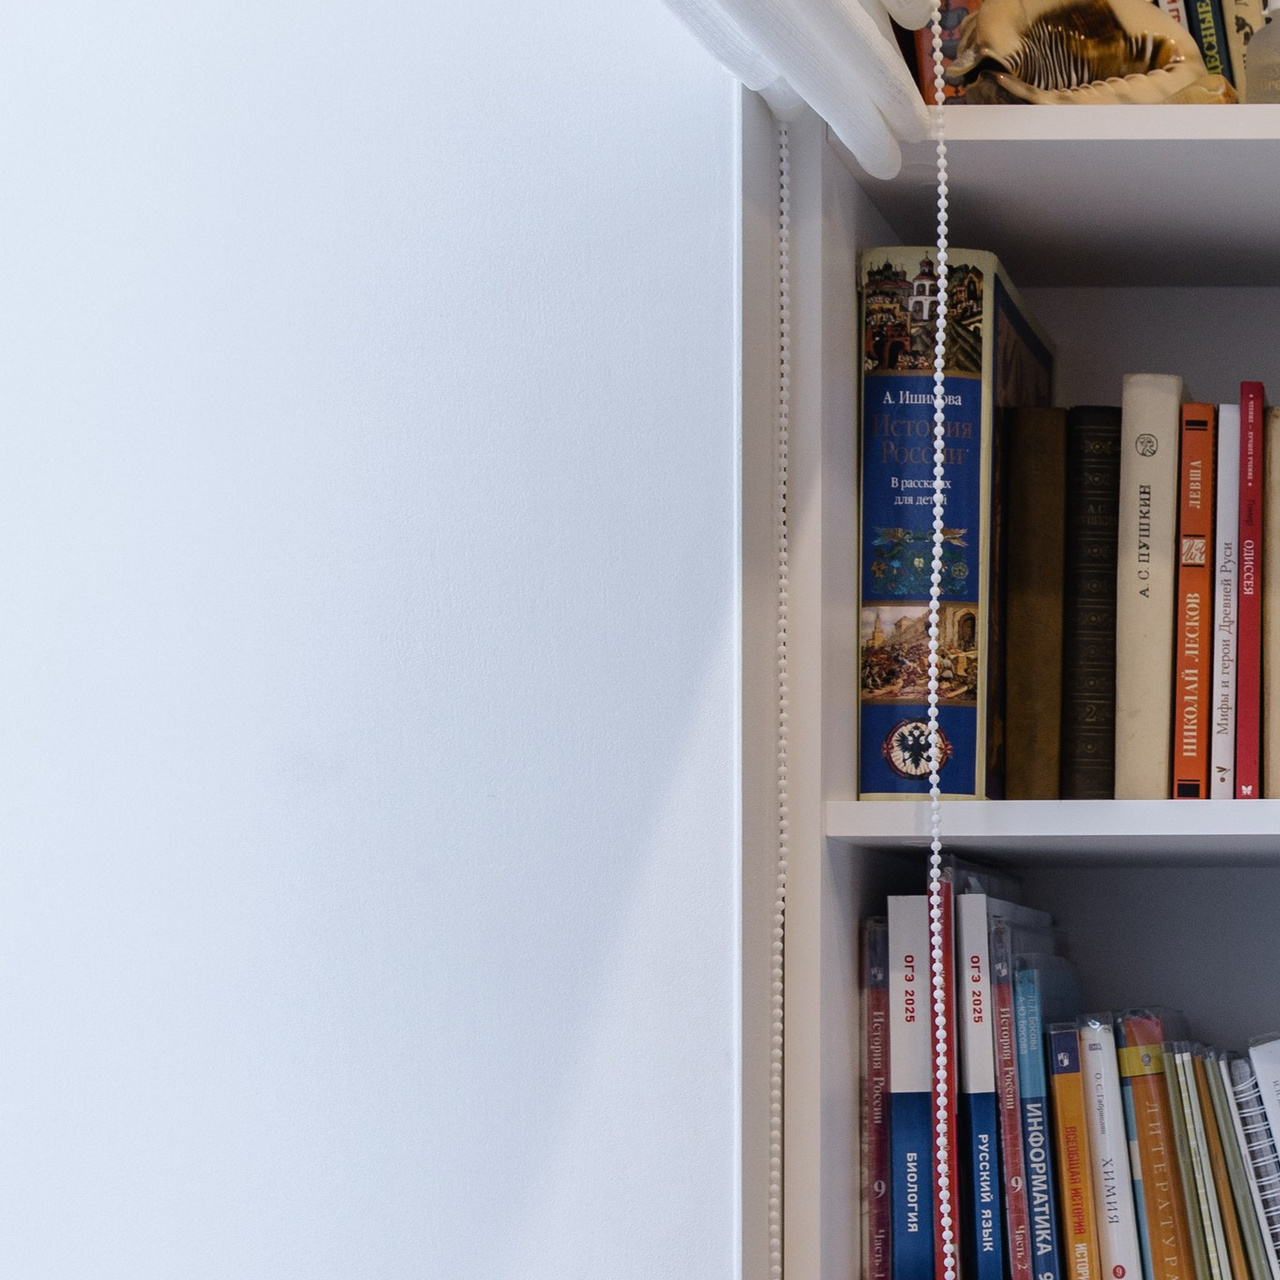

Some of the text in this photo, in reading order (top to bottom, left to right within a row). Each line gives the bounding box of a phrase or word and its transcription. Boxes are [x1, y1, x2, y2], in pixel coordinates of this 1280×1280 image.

[883, 390, 896, 404] А.
[890, 477, 899, 488] В
[894, 495, 914, 505] для
[1188, 459, 1202, 508] ЛЕВША
[1138, 484, 1151, 598] А. С. ПУШКИН
[1243, 539, 1255, 596] ОДИССЕЯ
[1216, 541, 1236, 735] Мифы и герои Древней Руси
[1181, 592, 1201, 757] НИКОЛАЙ ЛЕСКОВ
[904, 954, 915, 1023] ОГЭ 2025
[970, 954, 983, 1024] ОГЭ 2025
[871, 1010, 885, 1125] История России
[1000, 1007, 1015, 1110] История России
[873, 1180, 886, 1199] 9
[906, 1152, 919, 1233] БИОЛОГИЯ
[978, 1134, 994, 1252] РУССКИЙ ЯЗЫК
[1010, 1175, 1022, 1193] 9
[1026, 1102, 1053, 1256] ИНФОРМАТИКА
[1064, 1125, 1086, 1235] ВСЕОБЩАЯ ИСТОРИЯ
[1102, 1157, 1121, 1224] ХИМИЯ
[873, 1228, 885, 1267] Часть
[1014, 1224, 1027, 1271] Часть 2
